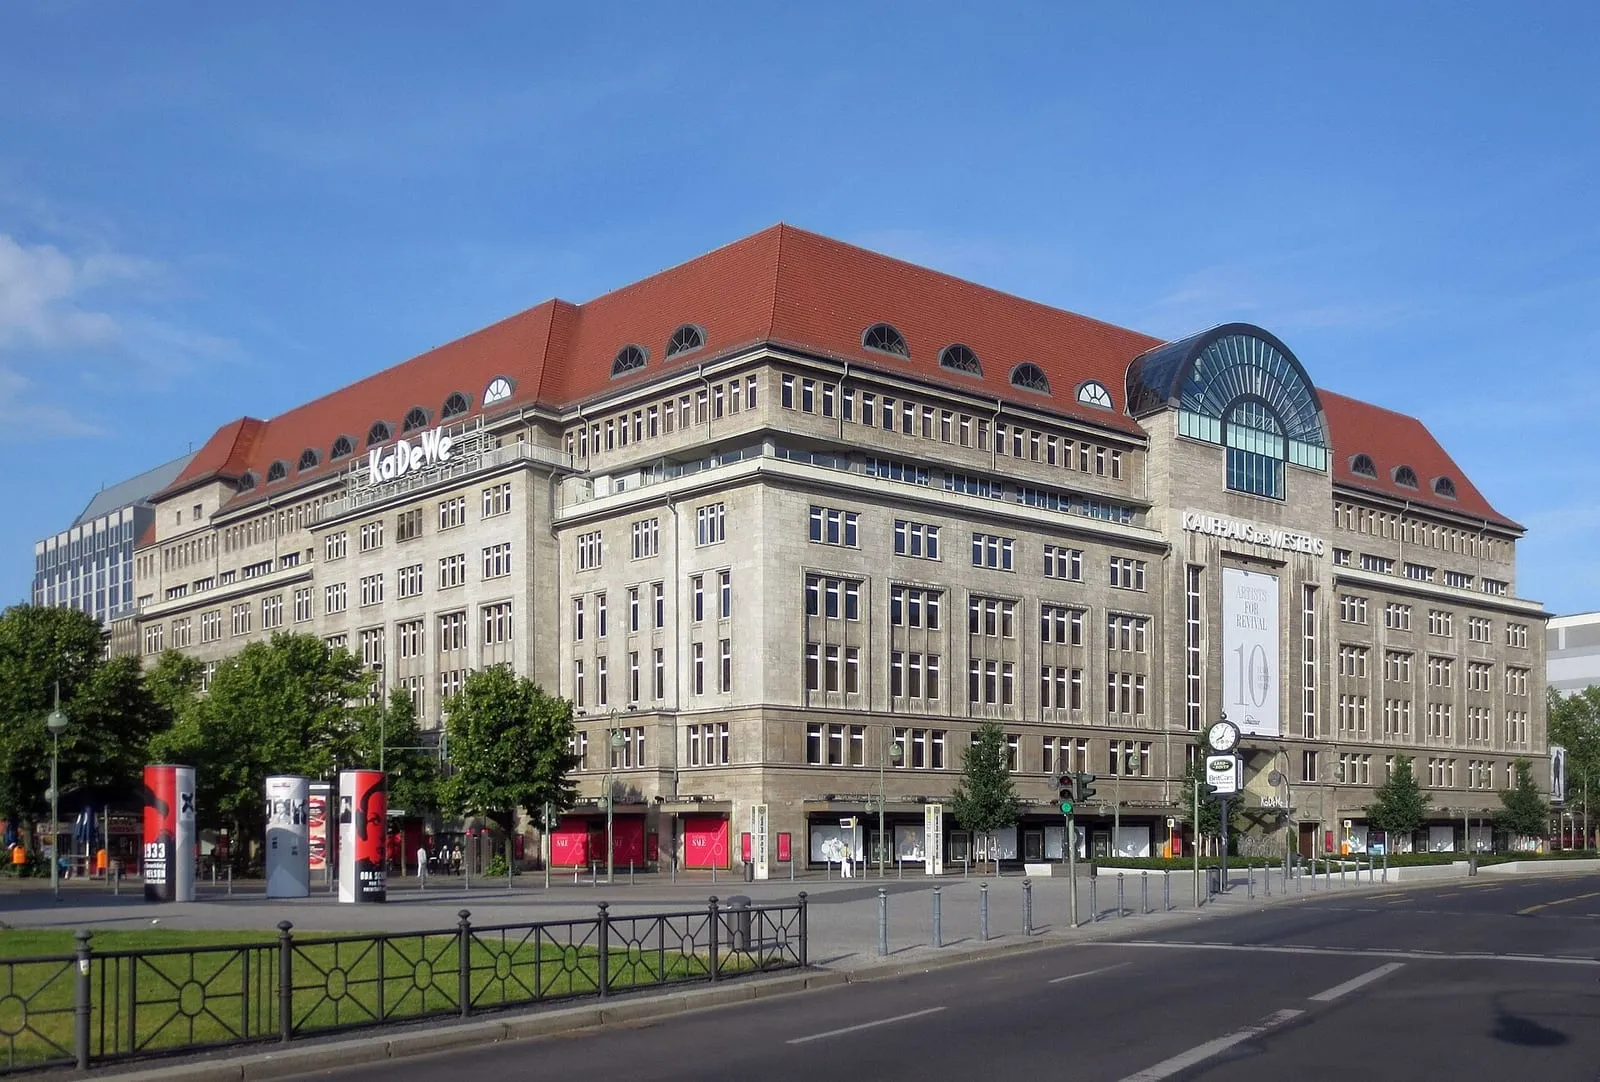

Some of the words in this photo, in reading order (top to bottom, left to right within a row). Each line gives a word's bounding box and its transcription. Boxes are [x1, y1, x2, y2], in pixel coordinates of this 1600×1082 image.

[369, 426, 452, 484] KaDeWe
[1182, 511, 1254, 544] KAUFHAUS
[1269, 529, 1324, 557] WESTENS
[1236, 613, 1267, 630] REVIVAL
[1244, 601, 1259, 615] FOR
[1233, 643, 1269, 708] 10
[692, 838, 706, 847] SALE
